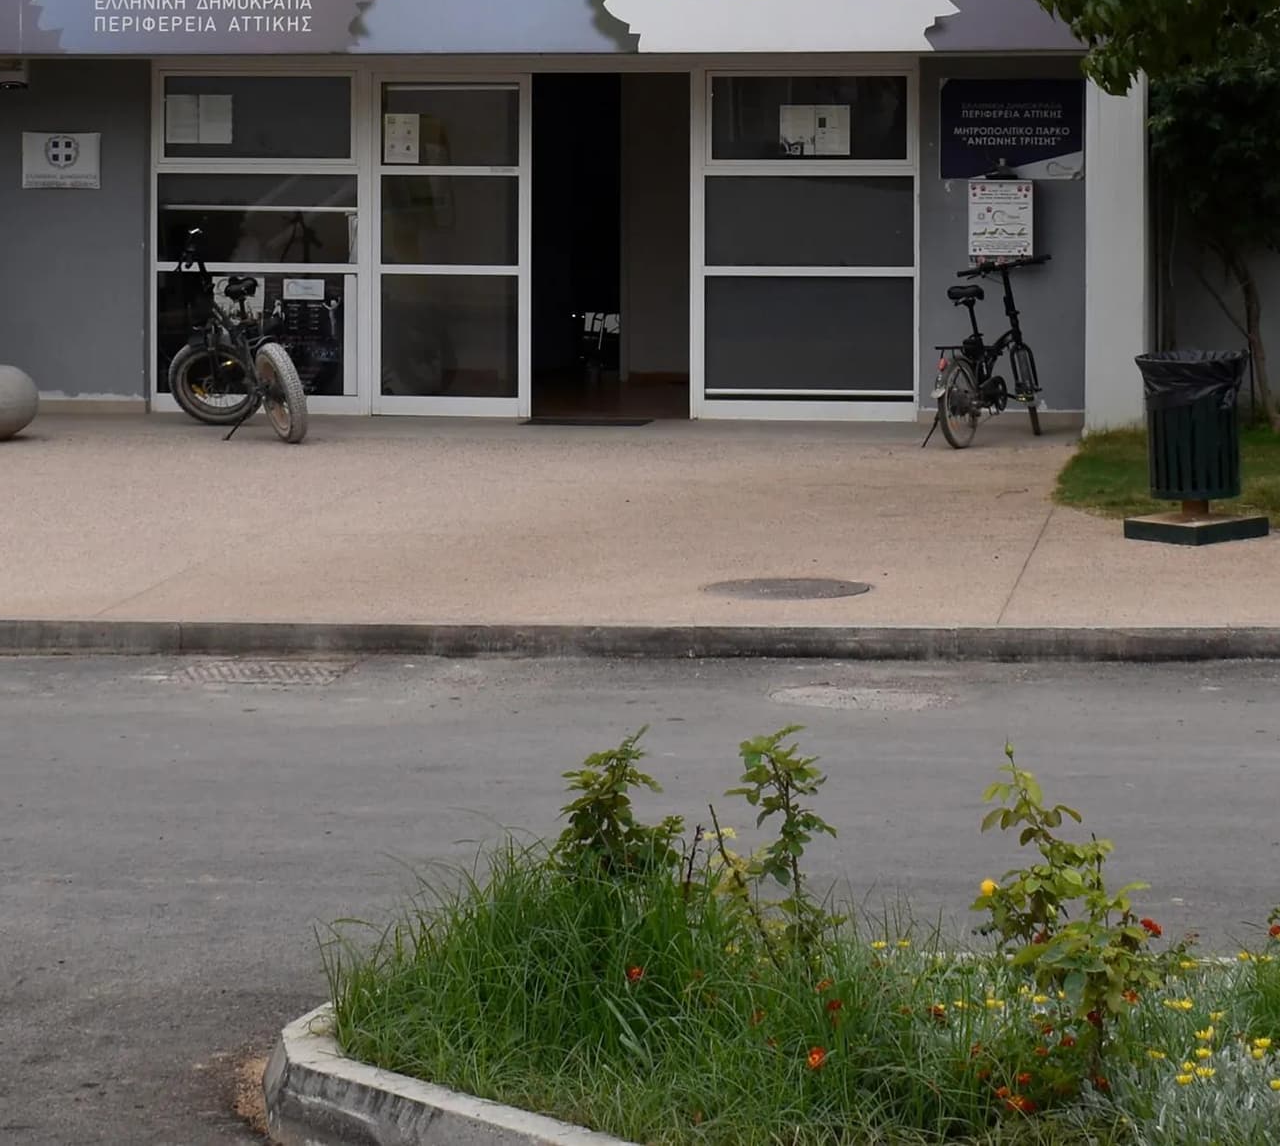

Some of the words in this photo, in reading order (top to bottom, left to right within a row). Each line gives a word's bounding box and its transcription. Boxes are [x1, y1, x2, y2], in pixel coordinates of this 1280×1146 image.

[94, 15, 217, 32] ΠΕΡΙΦΕΡΕΙΑ
[228, 15, 312, 32] ΑΤΤΙΚΗΣ
[961, 110, 1020, 119] ΠΕΡΙΦΕΡΕΙΑ
[1023, 110, 1063, 119] ΑΤΤΙΚΗΣ
[953, 126, 1033, 136] ΜΗΤΡΟΠΟΛΙΤΙΚΟ
[1035, 126, 1070, 136] ΠΑΡΚΟ
